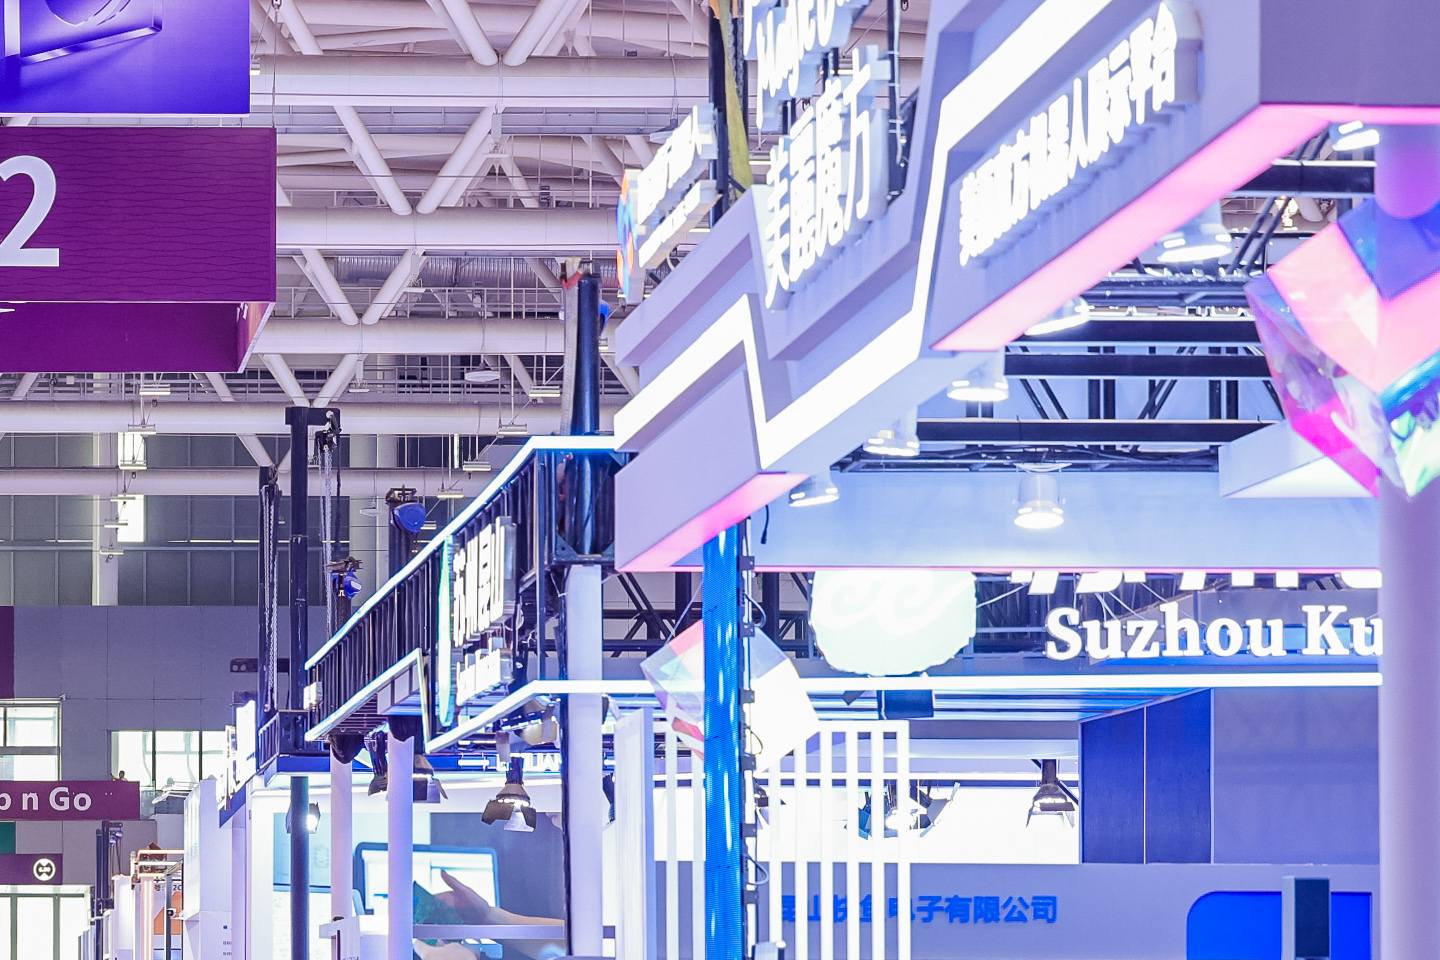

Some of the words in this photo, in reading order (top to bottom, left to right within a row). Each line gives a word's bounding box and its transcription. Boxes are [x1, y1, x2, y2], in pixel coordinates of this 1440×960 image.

[1045, 601, 1288, 661] Suzhou
[1301, 604, 1383, 657] Ku
[21, 792, 39, 811] n
[49, 786, 92, 812] Go
